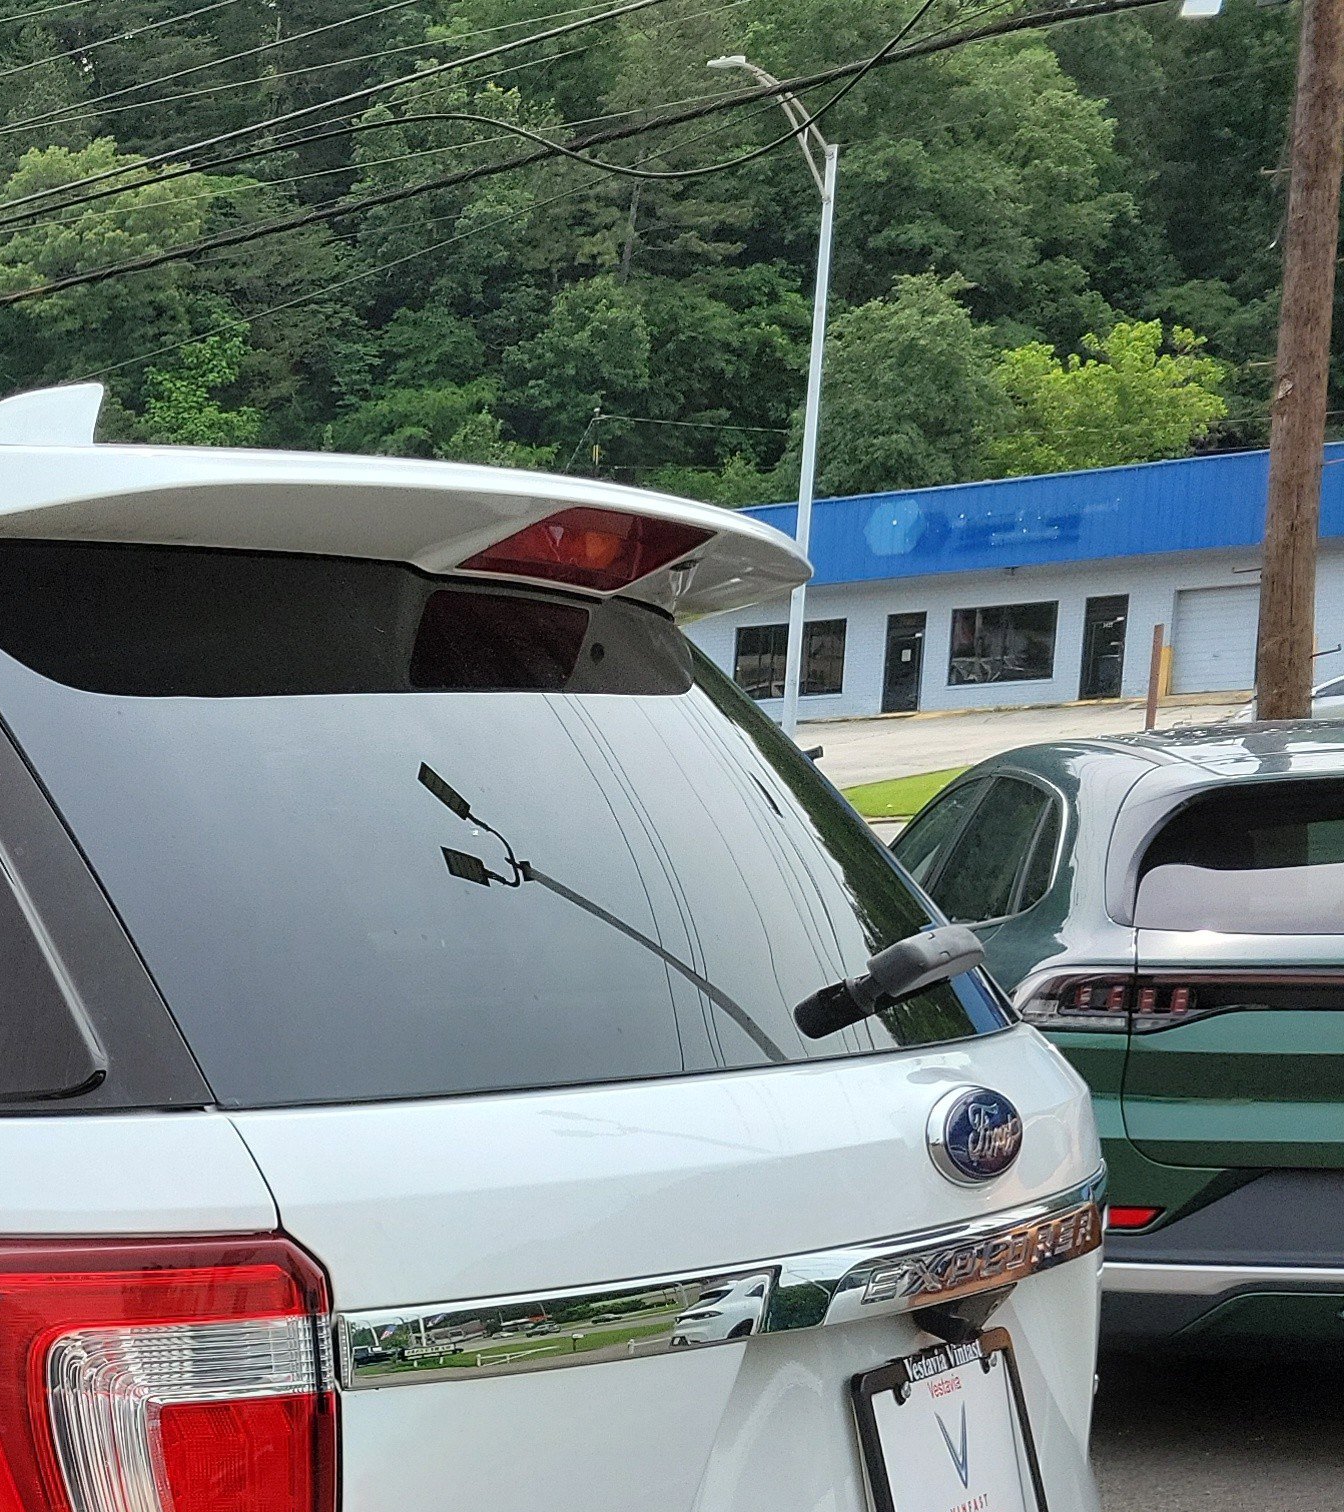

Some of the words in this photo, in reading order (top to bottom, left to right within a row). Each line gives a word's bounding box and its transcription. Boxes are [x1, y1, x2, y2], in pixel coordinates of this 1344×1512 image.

[967, 1102, 1021, 1166] Ford
[860, 1207, 1094, 1306] EXPLORER
[902, 1347, 948, 1382] Vestavia
